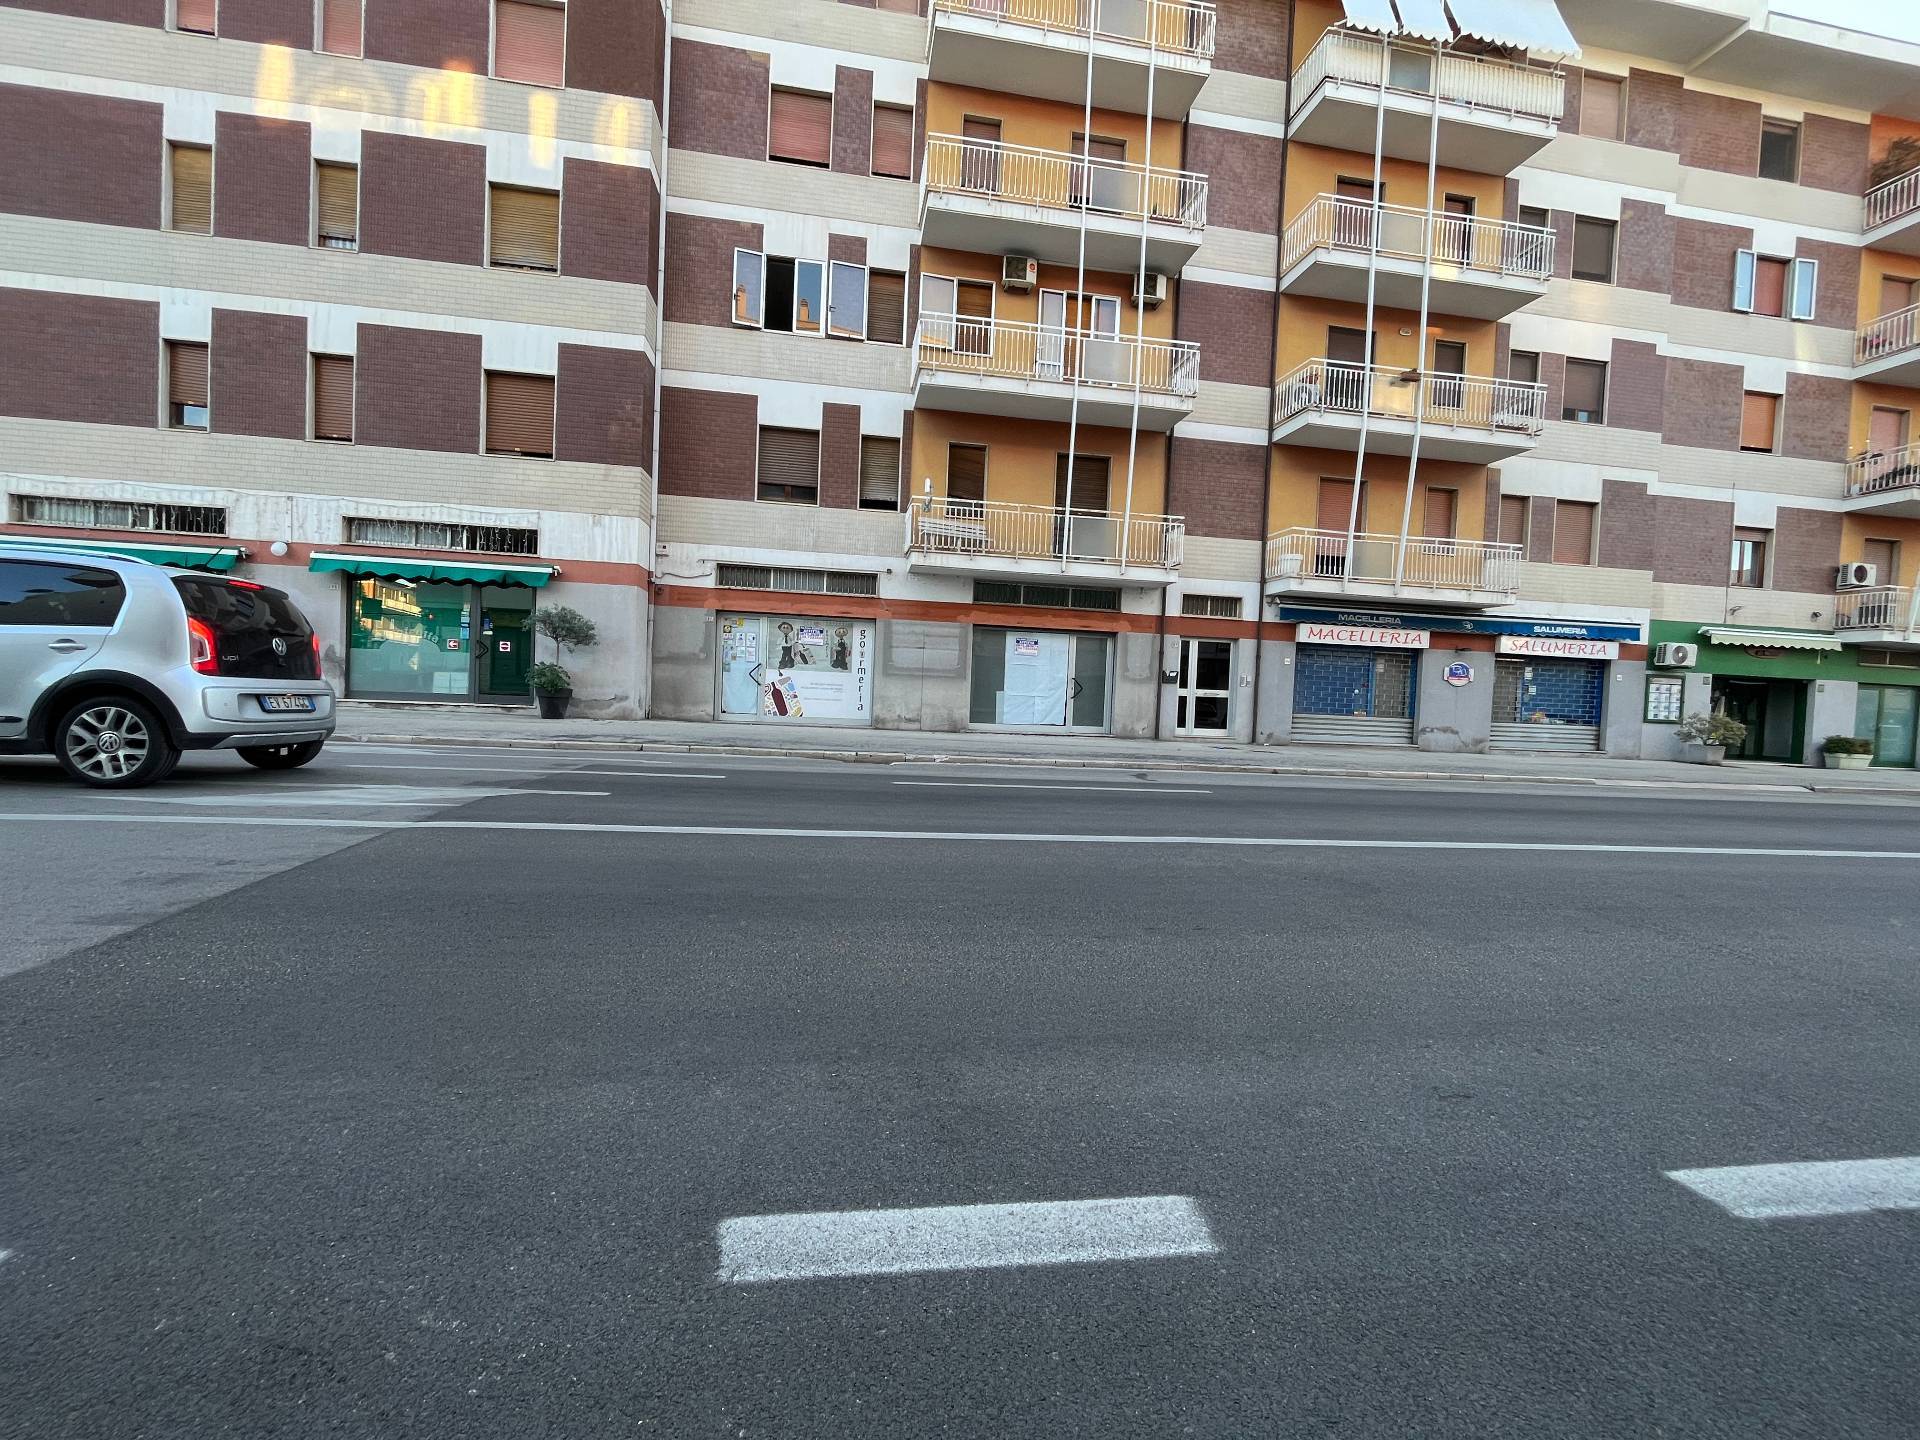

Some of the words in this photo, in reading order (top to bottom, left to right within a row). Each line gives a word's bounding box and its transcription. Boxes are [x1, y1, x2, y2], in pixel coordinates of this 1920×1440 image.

[1338, 614, 1402, 625] MACELLERIA
[1307, 626, 1422, 645] MACELLERIA
[1533, 625, 1588, 636] SALUMERIA
[1509, 639, 1608, 656] SALUMERIA
